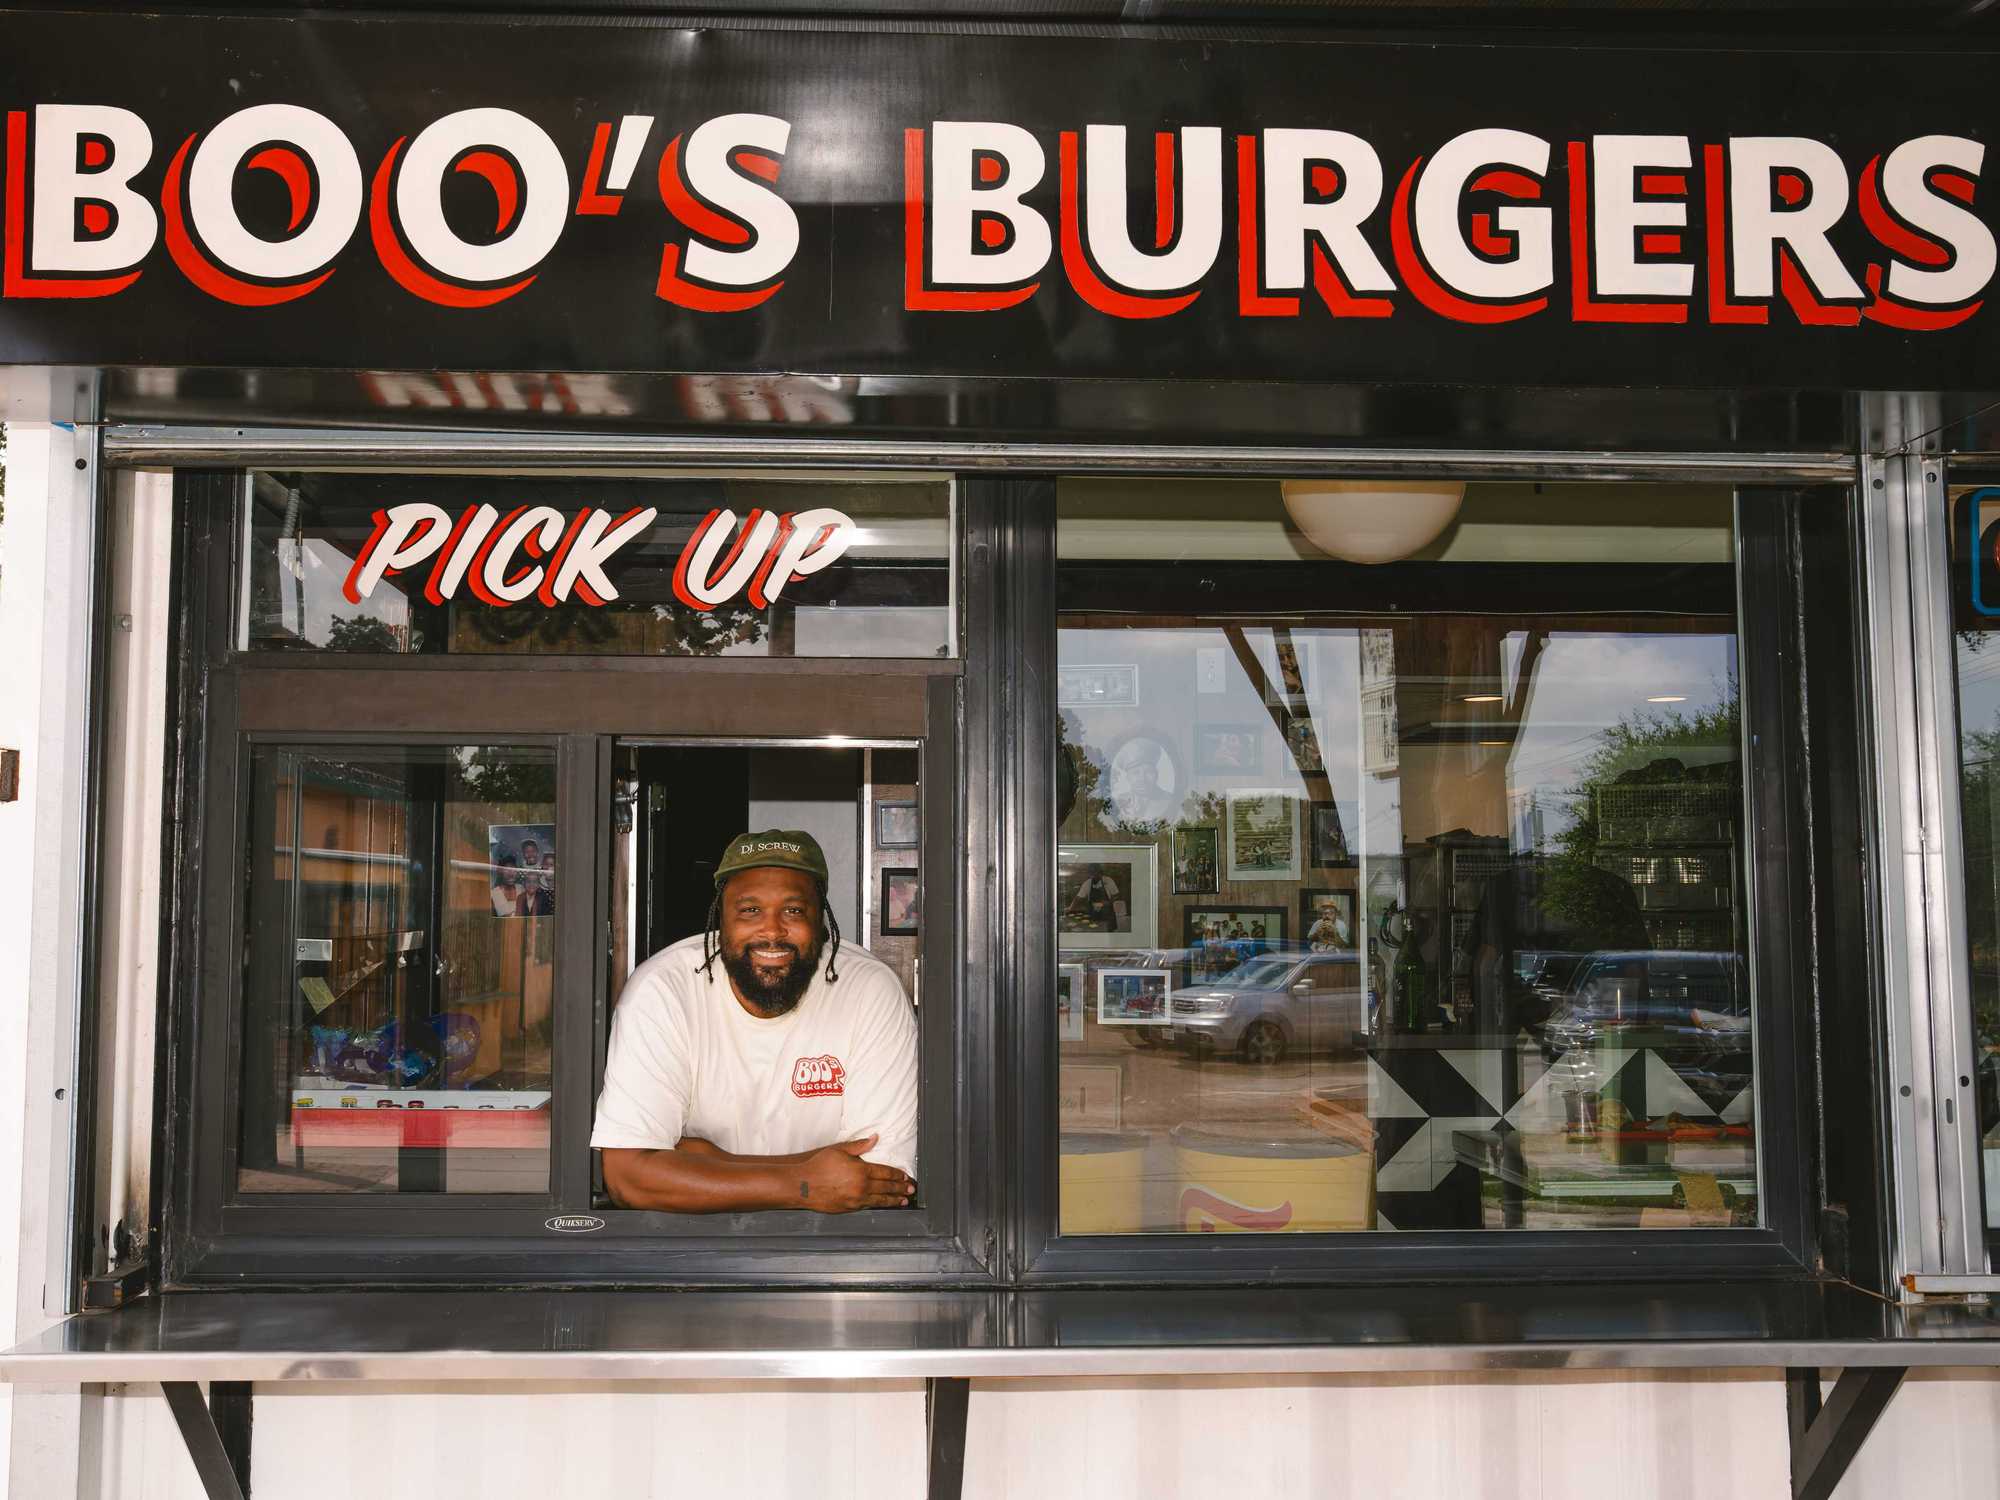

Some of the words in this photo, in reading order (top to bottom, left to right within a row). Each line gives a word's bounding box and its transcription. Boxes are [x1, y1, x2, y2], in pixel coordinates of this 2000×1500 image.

[3, 103, 801, 312] BOO'S
[905, 121, 1998, 331] BURGERS
[343, 502, 658, 608] PICK
[672, 507, 857, 611] UP
[757, 842, 801, 853] SCREW
[794, 1082, 840, 1092] BURGERS
